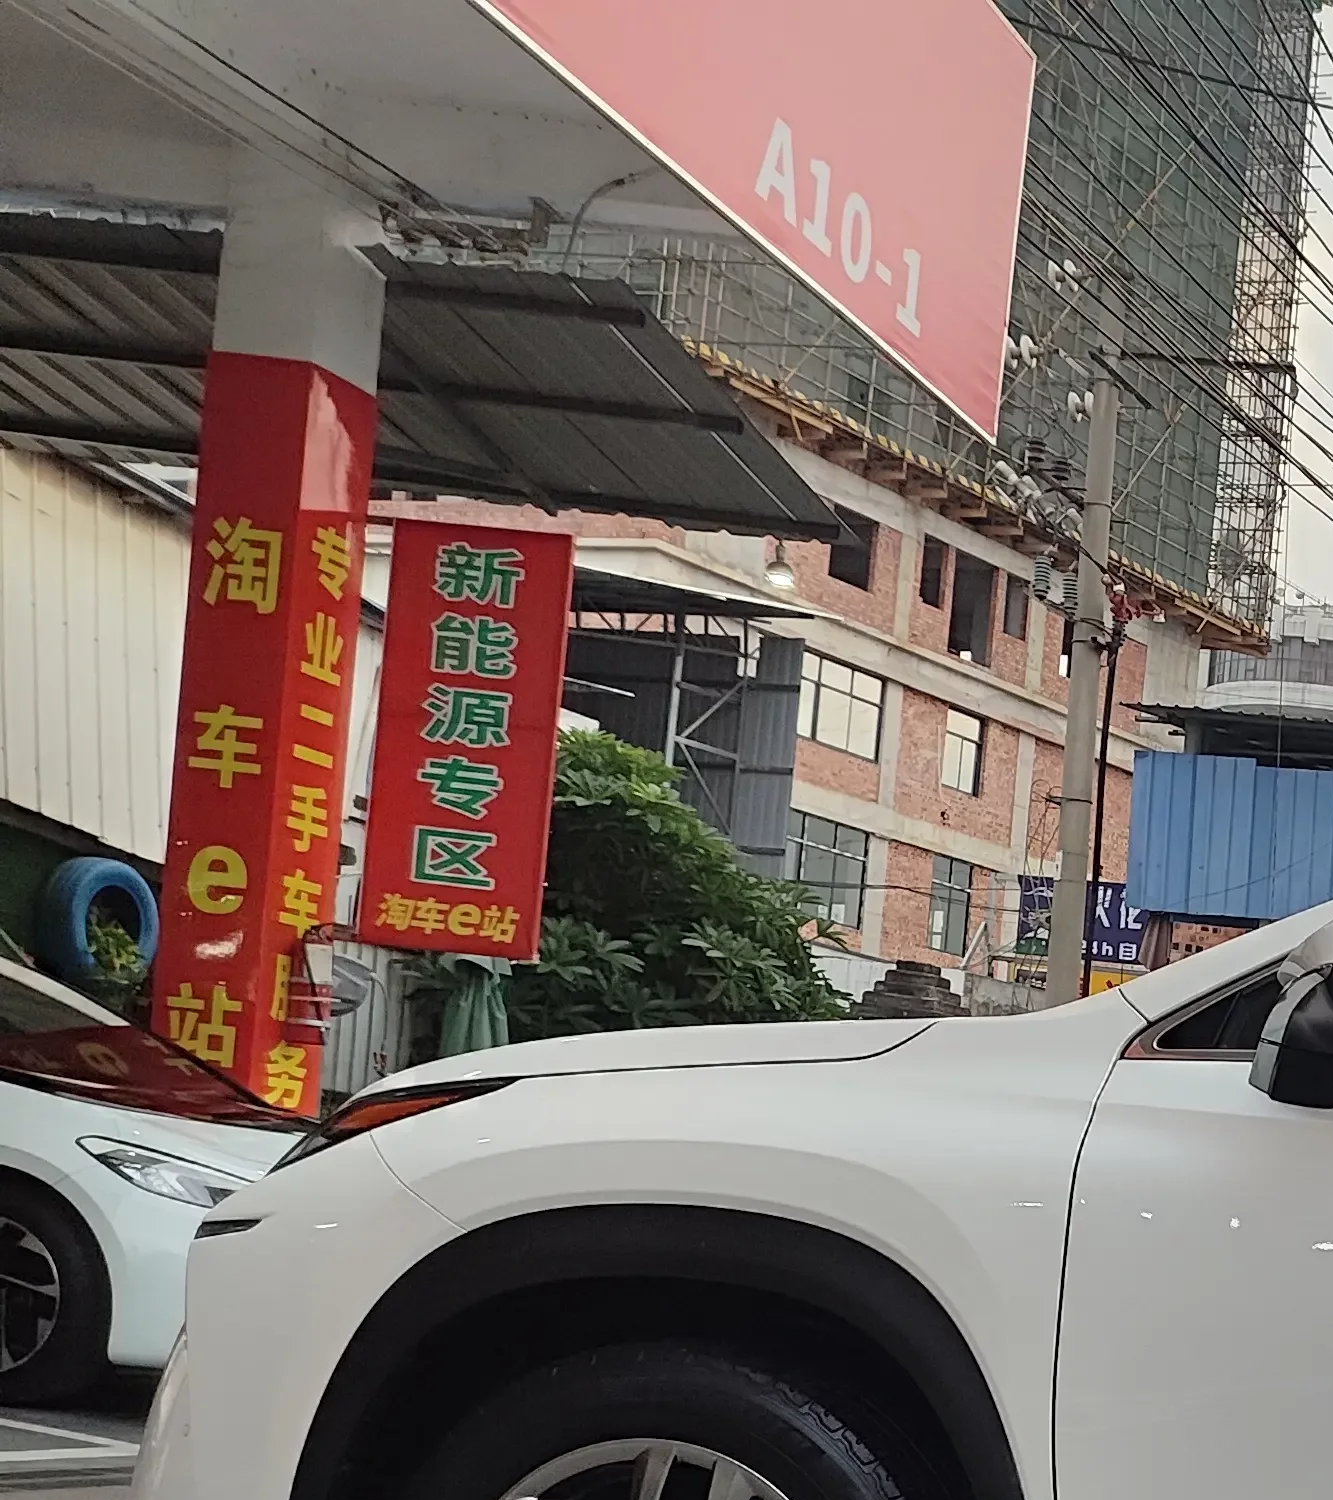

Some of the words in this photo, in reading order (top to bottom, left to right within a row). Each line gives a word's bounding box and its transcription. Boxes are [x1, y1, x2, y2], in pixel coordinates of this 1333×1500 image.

[754, 117, 922, 337] A10-1
[167, 516, 282, 1068] 淘车e站
[410, 541, 525, 891] 新能源专区
[375, 892, 521, 944] 淘车e站
